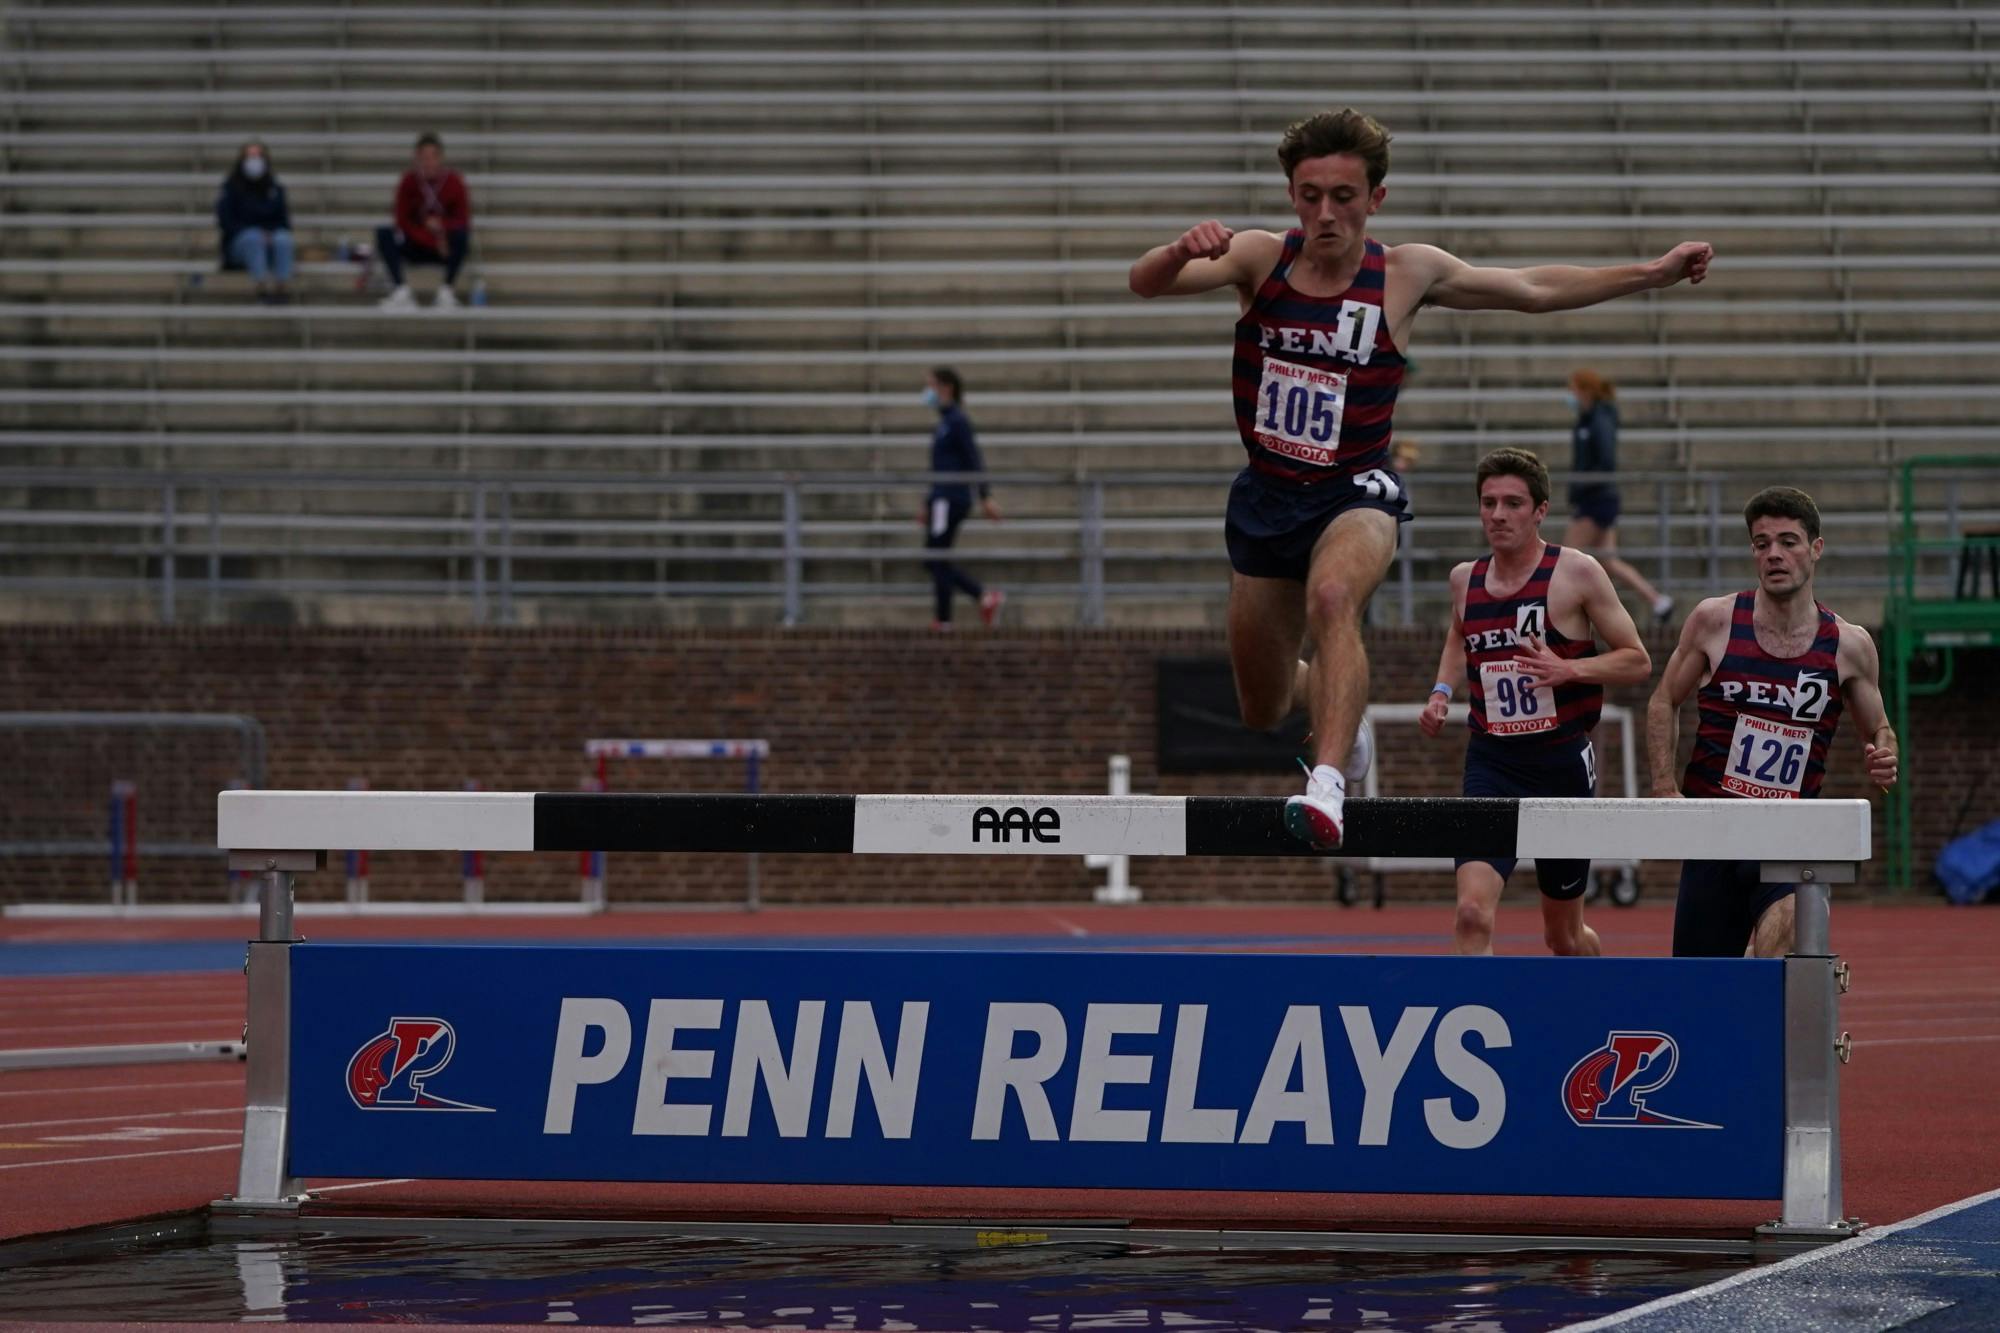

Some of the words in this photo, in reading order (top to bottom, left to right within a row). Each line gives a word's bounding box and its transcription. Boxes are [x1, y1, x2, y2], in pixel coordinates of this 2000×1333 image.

[1347, 306, 1368, 350] 1
[1268, 362, 1305, 380] PHILLY
[1307, 371, 1339, 387] METS
[1263, 381, 1337, 442] 105
[1275, 440, 1330, 462] TOYOTA
[1520, 609, 1540, 638] 4
[1466, 627, 1546, 653] PEN
[1486, 663, 1514, 673] PHILLY
[1496, 676, 1538, 717] 98
[1720, 681, 1832, 709] PEN
[1796, 681, 1823, 719] 2
[1505, 719, 1552, 733] TOYOTA
[1745, 719, 1780, 734] PHILLY
[1782, 727, 1808, 739] METS
[1734, 734, 1804, 785] 126
[1745, 784, 1792, 799] TOYOTA
[543, 997, 930, 1139] PENN
[970, 1002, 1513, 1149] RELAYS
